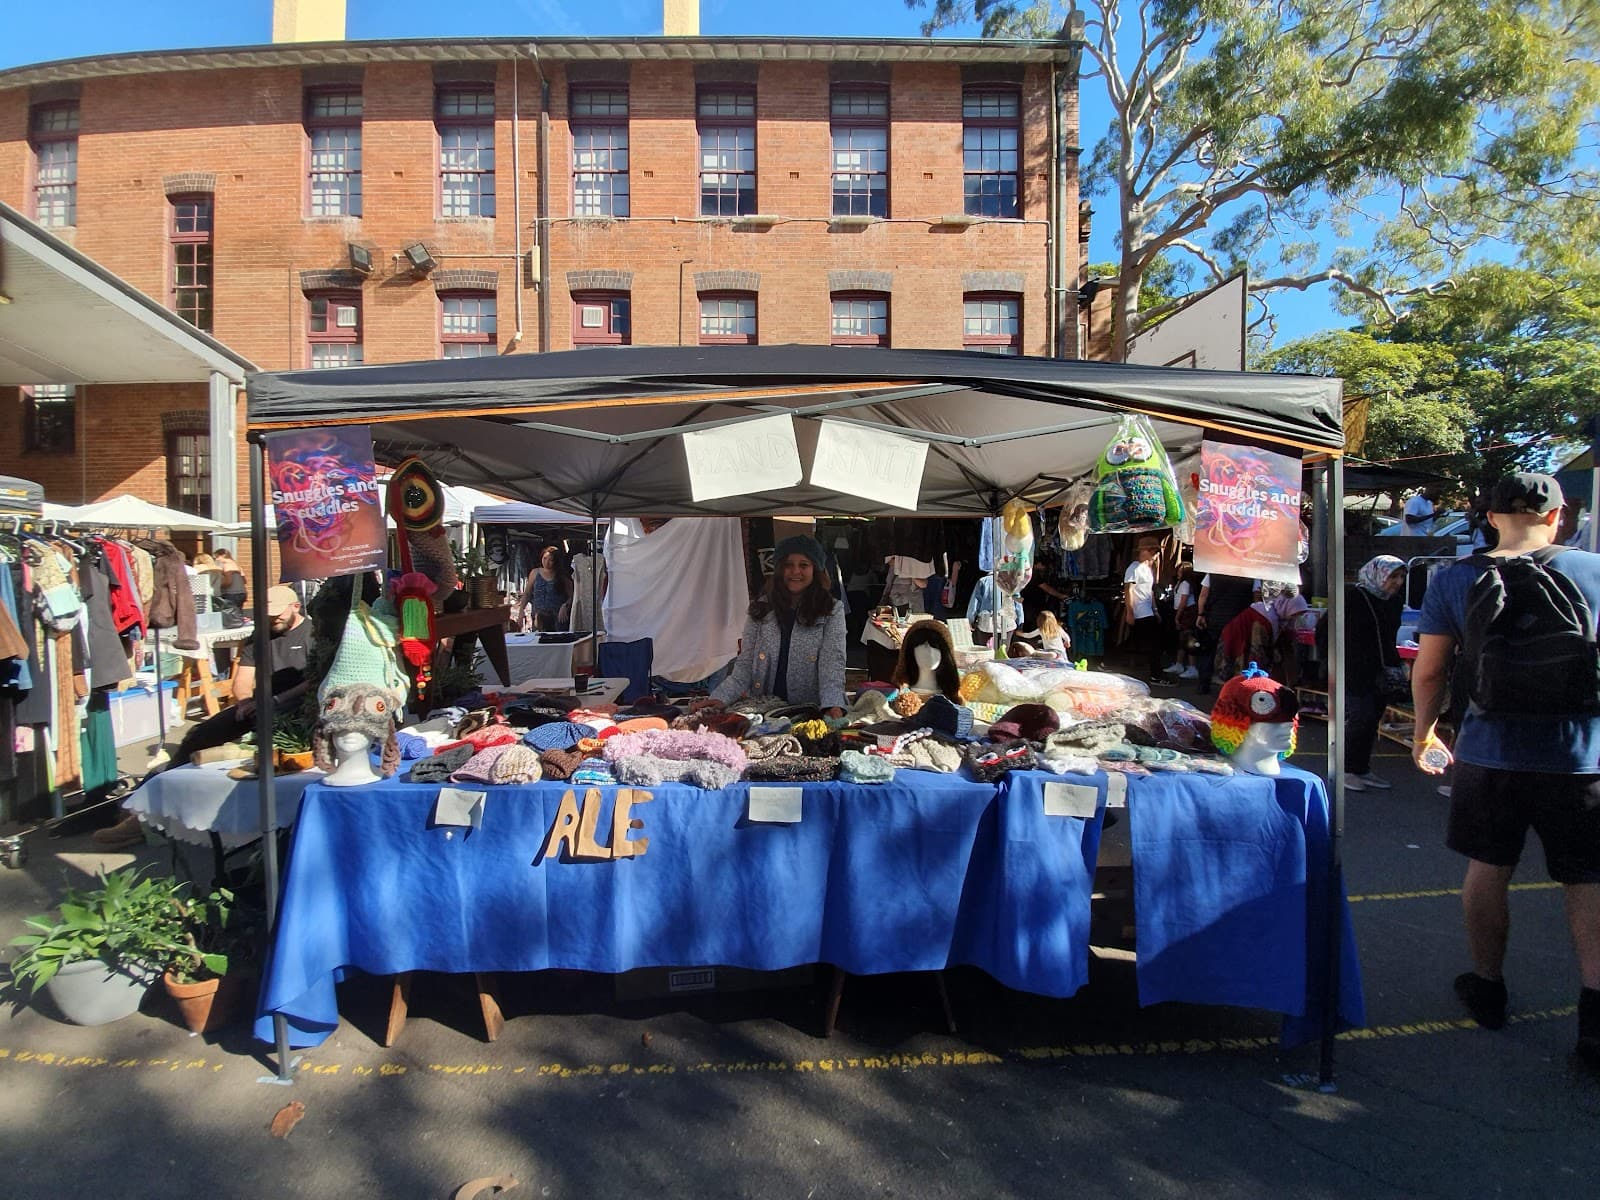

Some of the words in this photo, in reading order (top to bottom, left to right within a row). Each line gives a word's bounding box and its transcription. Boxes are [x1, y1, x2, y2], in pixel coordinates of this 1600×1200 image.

[272, 482, 345, 504] Snuggles
[347, 476, 378, 494] and
[1199, 478, 1268, 501] Snuggles
[1270, 491, 1300, 506] and
[298, 500, 360, 518] cuddles
[1219, 502, 1278, 520] cuddles
[545, 787, 654, 858] ALE
